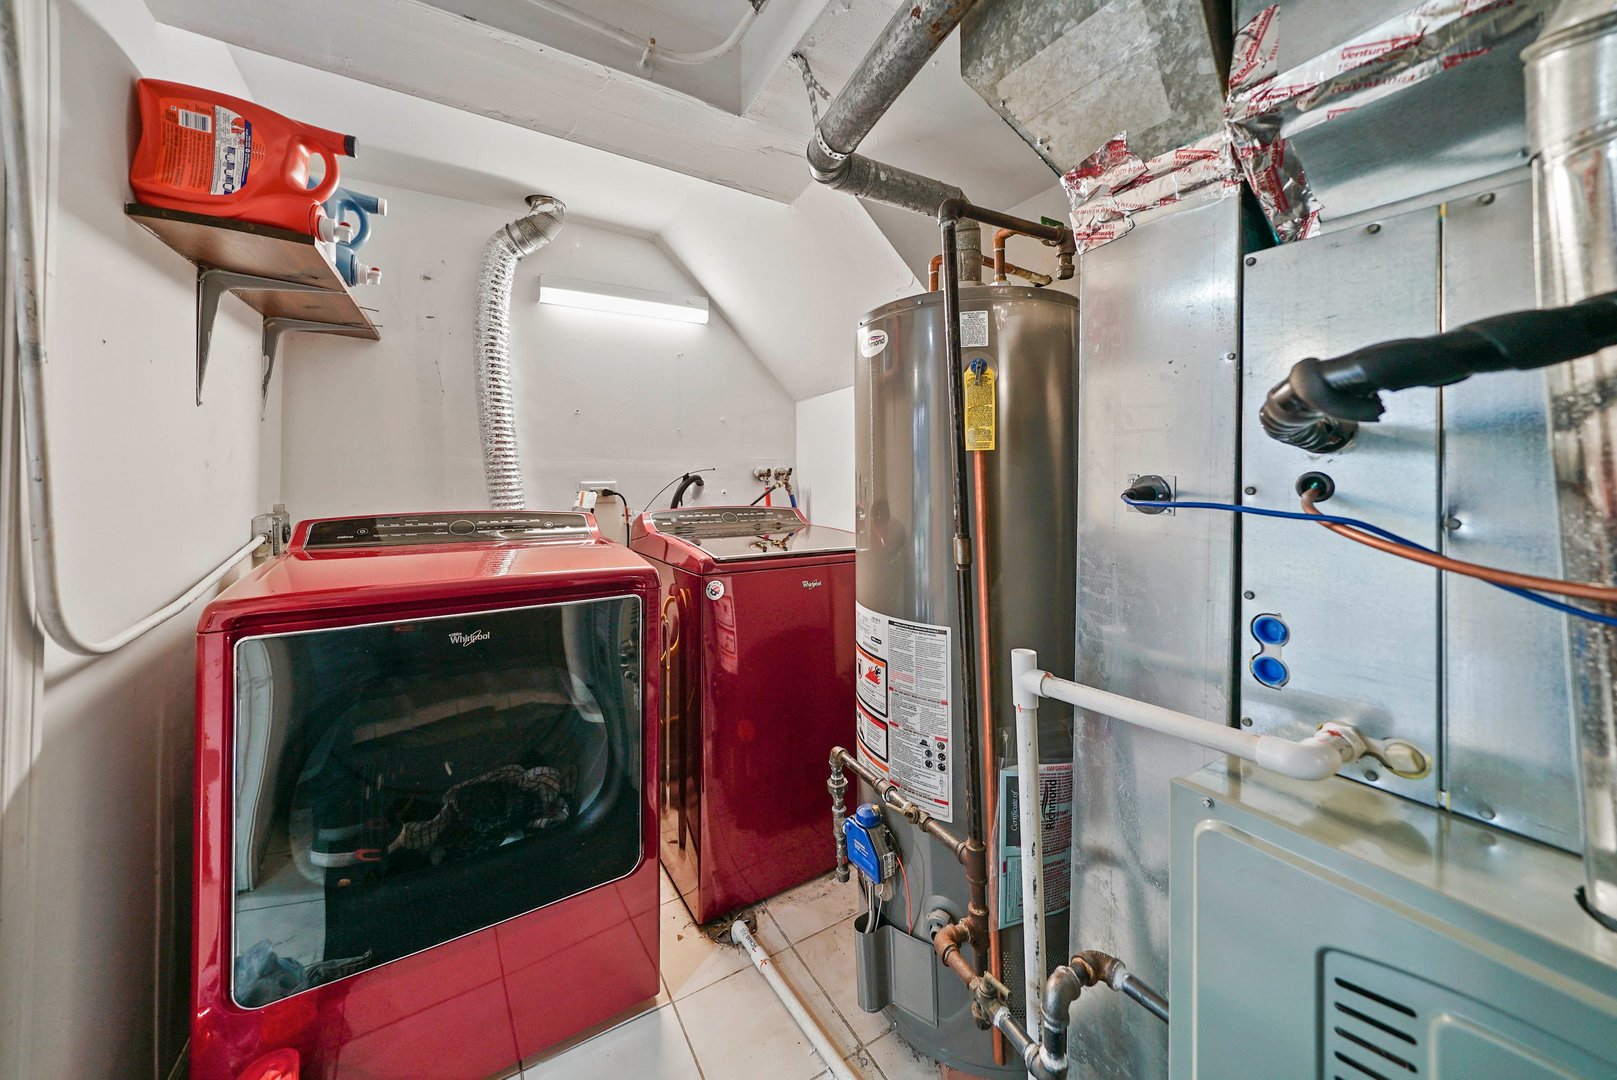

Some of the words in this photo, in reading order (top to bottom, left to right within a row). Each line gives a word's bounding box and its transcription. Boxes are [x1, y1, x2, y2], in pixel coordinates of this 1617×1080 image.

[449, 630, 491, 647] Whirlpool
[1010, 798, 1019, 831] Certificate
[1045, 780, 1057, 830] Richmond
